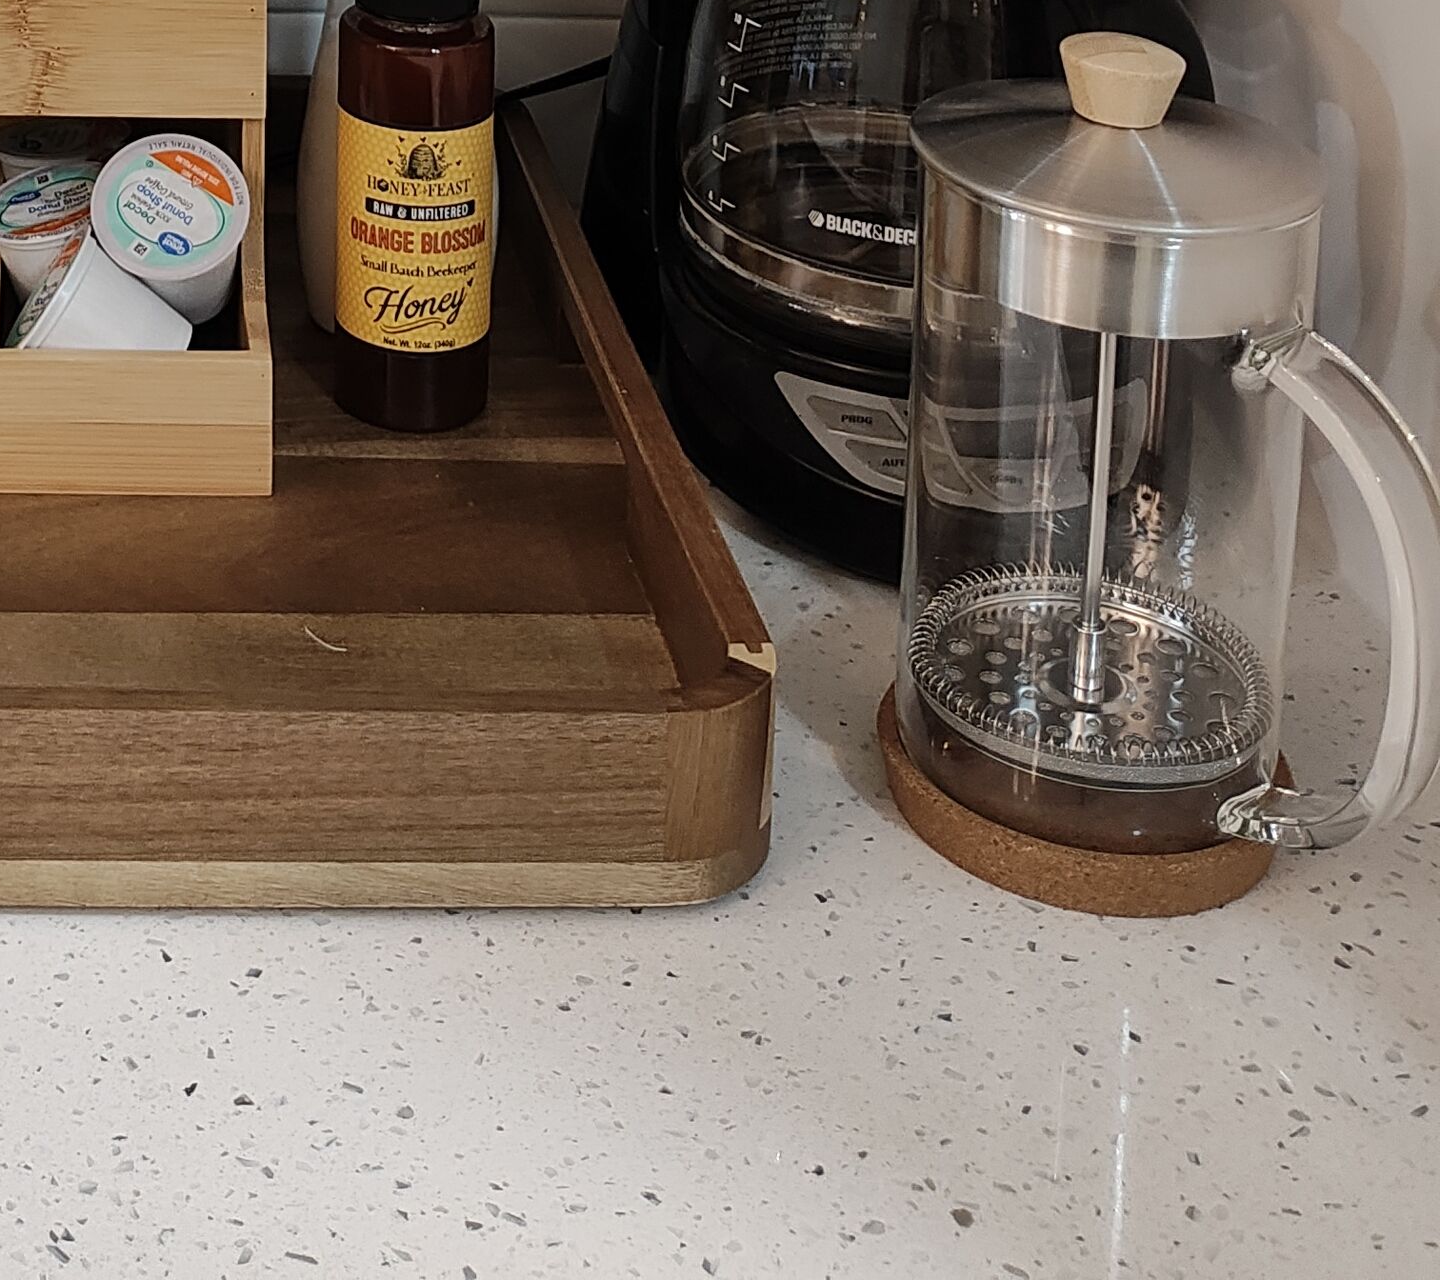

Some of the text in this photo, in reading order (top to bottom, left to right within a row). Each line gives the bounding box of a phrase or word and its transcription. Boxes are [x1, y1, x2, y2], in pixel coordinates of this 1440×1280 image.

[148, 140, 168, 151] SALE
[170, 140, 196, 151] RETAIL
[136, 183, 194, 226] Donut Shop
[144, 176, 194, 211] Ground Coffee
[27, 201, 61, 214] Donut
[122, 200, 156, 225] Decaf
[372, 200, 469, 221] RAW & UNFILTERED
[350, 216, 486, 255] ORANGE BLOSSOM
[826, 213, 917, 246] BLACK&DEC
[360, 254, 477, 278] Small Batch Beekeeper
[364, 284, 467, 325] Honey
[434, 338, 456, 349] (340g)
[841, 413, 873, 425] PROG
[881, 457, 905, 467] AUT
